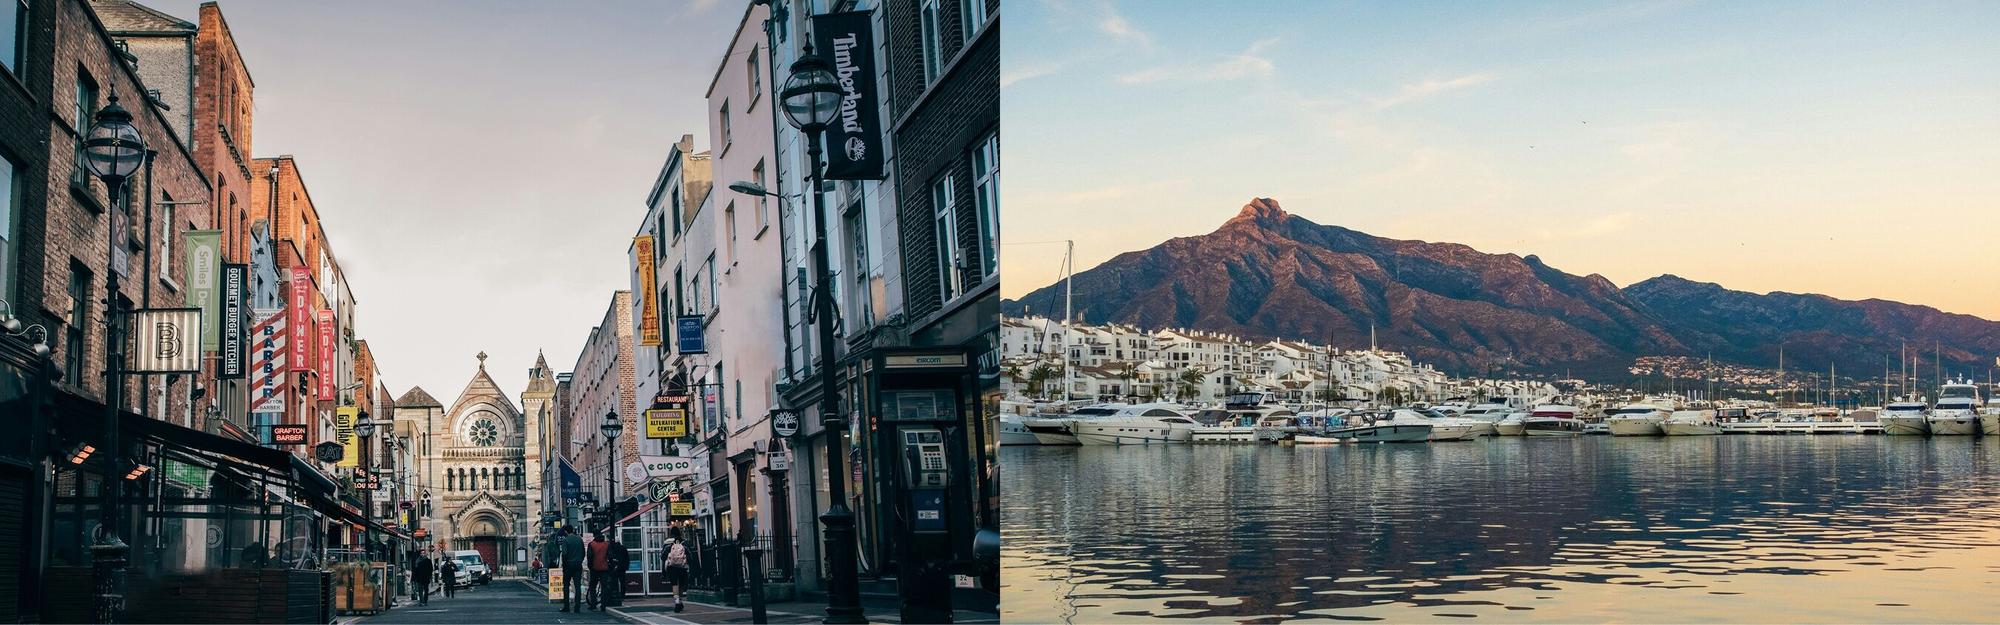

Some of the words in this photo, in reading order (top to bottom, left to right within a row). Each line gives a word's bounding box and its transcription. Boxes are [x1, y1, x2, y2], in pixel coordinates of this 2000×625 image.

[833, 33, 863, 133] Timberland
[198, 251, 209, 285] Smiles
[229, 267, 238, 305] GOURMET
[156, 322, 181, 359] B
[228, 307, 237, 338] BURGER
[296, 294, 306, 368] DINER
[227, 339, 237, 375] KITCHEN
[263, 325, 275, 398] BARBER
[321, 336, 330, 397] DINER
[274, 427, 306, 435] GRAFTON
[276, 434, 304, 442] BARBER
[657, 462, 673, 471] cig
[675, 461, 689, 469] co
